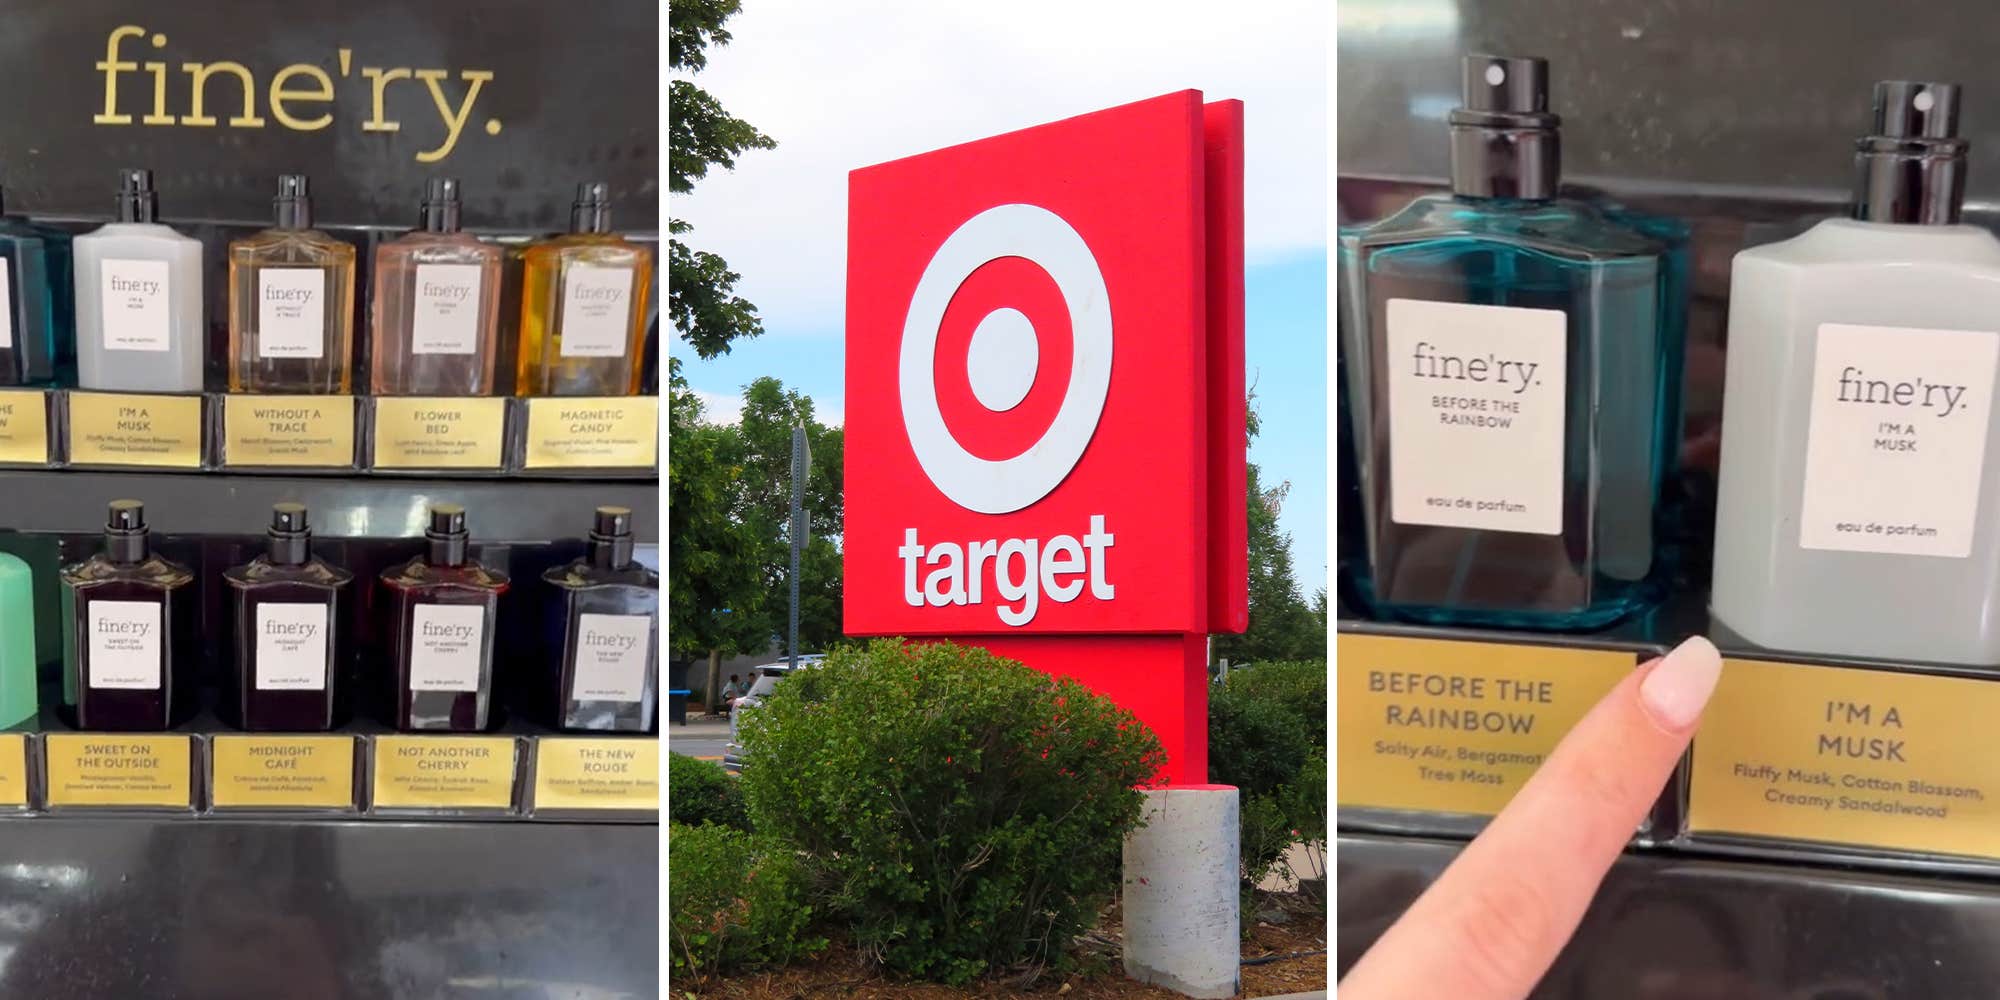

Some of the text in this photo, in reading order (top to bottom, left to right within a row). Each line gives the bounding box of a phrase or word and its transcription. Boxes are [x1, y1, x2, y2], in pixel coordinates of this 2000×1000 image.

[93, 24, 502, 162] fine'ry.
[1413, 341, 1541, 394] fine'ry.
[1837, 366, 1968, 418] fine'ry.
[1432, 396, 1520, 414] BEFORE THE
[119, 408, 149, 418] I'M A
[254, 408, 321, 419] WITHOUT A
[414, 411, 462, 421] FLOWER
[560, 410, 624, 420] MAGNETIC
[1440, 412, 1512, 429] RAINBOW
[117, 421, 151, 431] MUSK
[270, 422, 307, 432] TRACE
[426, 425, 449, 434] BED
[570, 423, 613, 433] CANDY
[1878, 422, 1915, 435] I'M A
[1874, 438, 1917, 451] MUSK
[1426, 496, 1526, 513] eau de parfum
[1836, 522, 1937, 537] eau de parfum
[898, 515, 1115, 626] target
[98, 617, 150, 637] fine'ry.
[266, 619, 317, 637] fine'ry.
[423, 621, 474, 640] fine'ry.
[1369, 670, 1553, 703] BEFORE THE
[1386, 704, 1535, 735] RAINBOW
[1826, 701, 1902, 728] I'M A
[84, 744, 150, 754] SWEET ON
[249, 745, 314, 756] MIDNIGHT
[398, 747, 490, 758] NOT ANOTHER
[580, 749, 636, 759] THE NEW
[1375, 740, 1418, 759] Salty
[1818, 734, 1906, 762] MUSK
[76, 758, 160, 768] THE OUTSIDE
[265, 757, 297, 769] CAFÉ
[417, 760, 469, 770] CHERRY
[584, 762, 628, 773] ROUGE
[1418, 766, 1504, 785] Tree Moss
[1734, 763, 1985, 801] Fluffy Musk, Cotton Blossom,
[1764, 788, 1947, 818] Creamy Sandalwood
